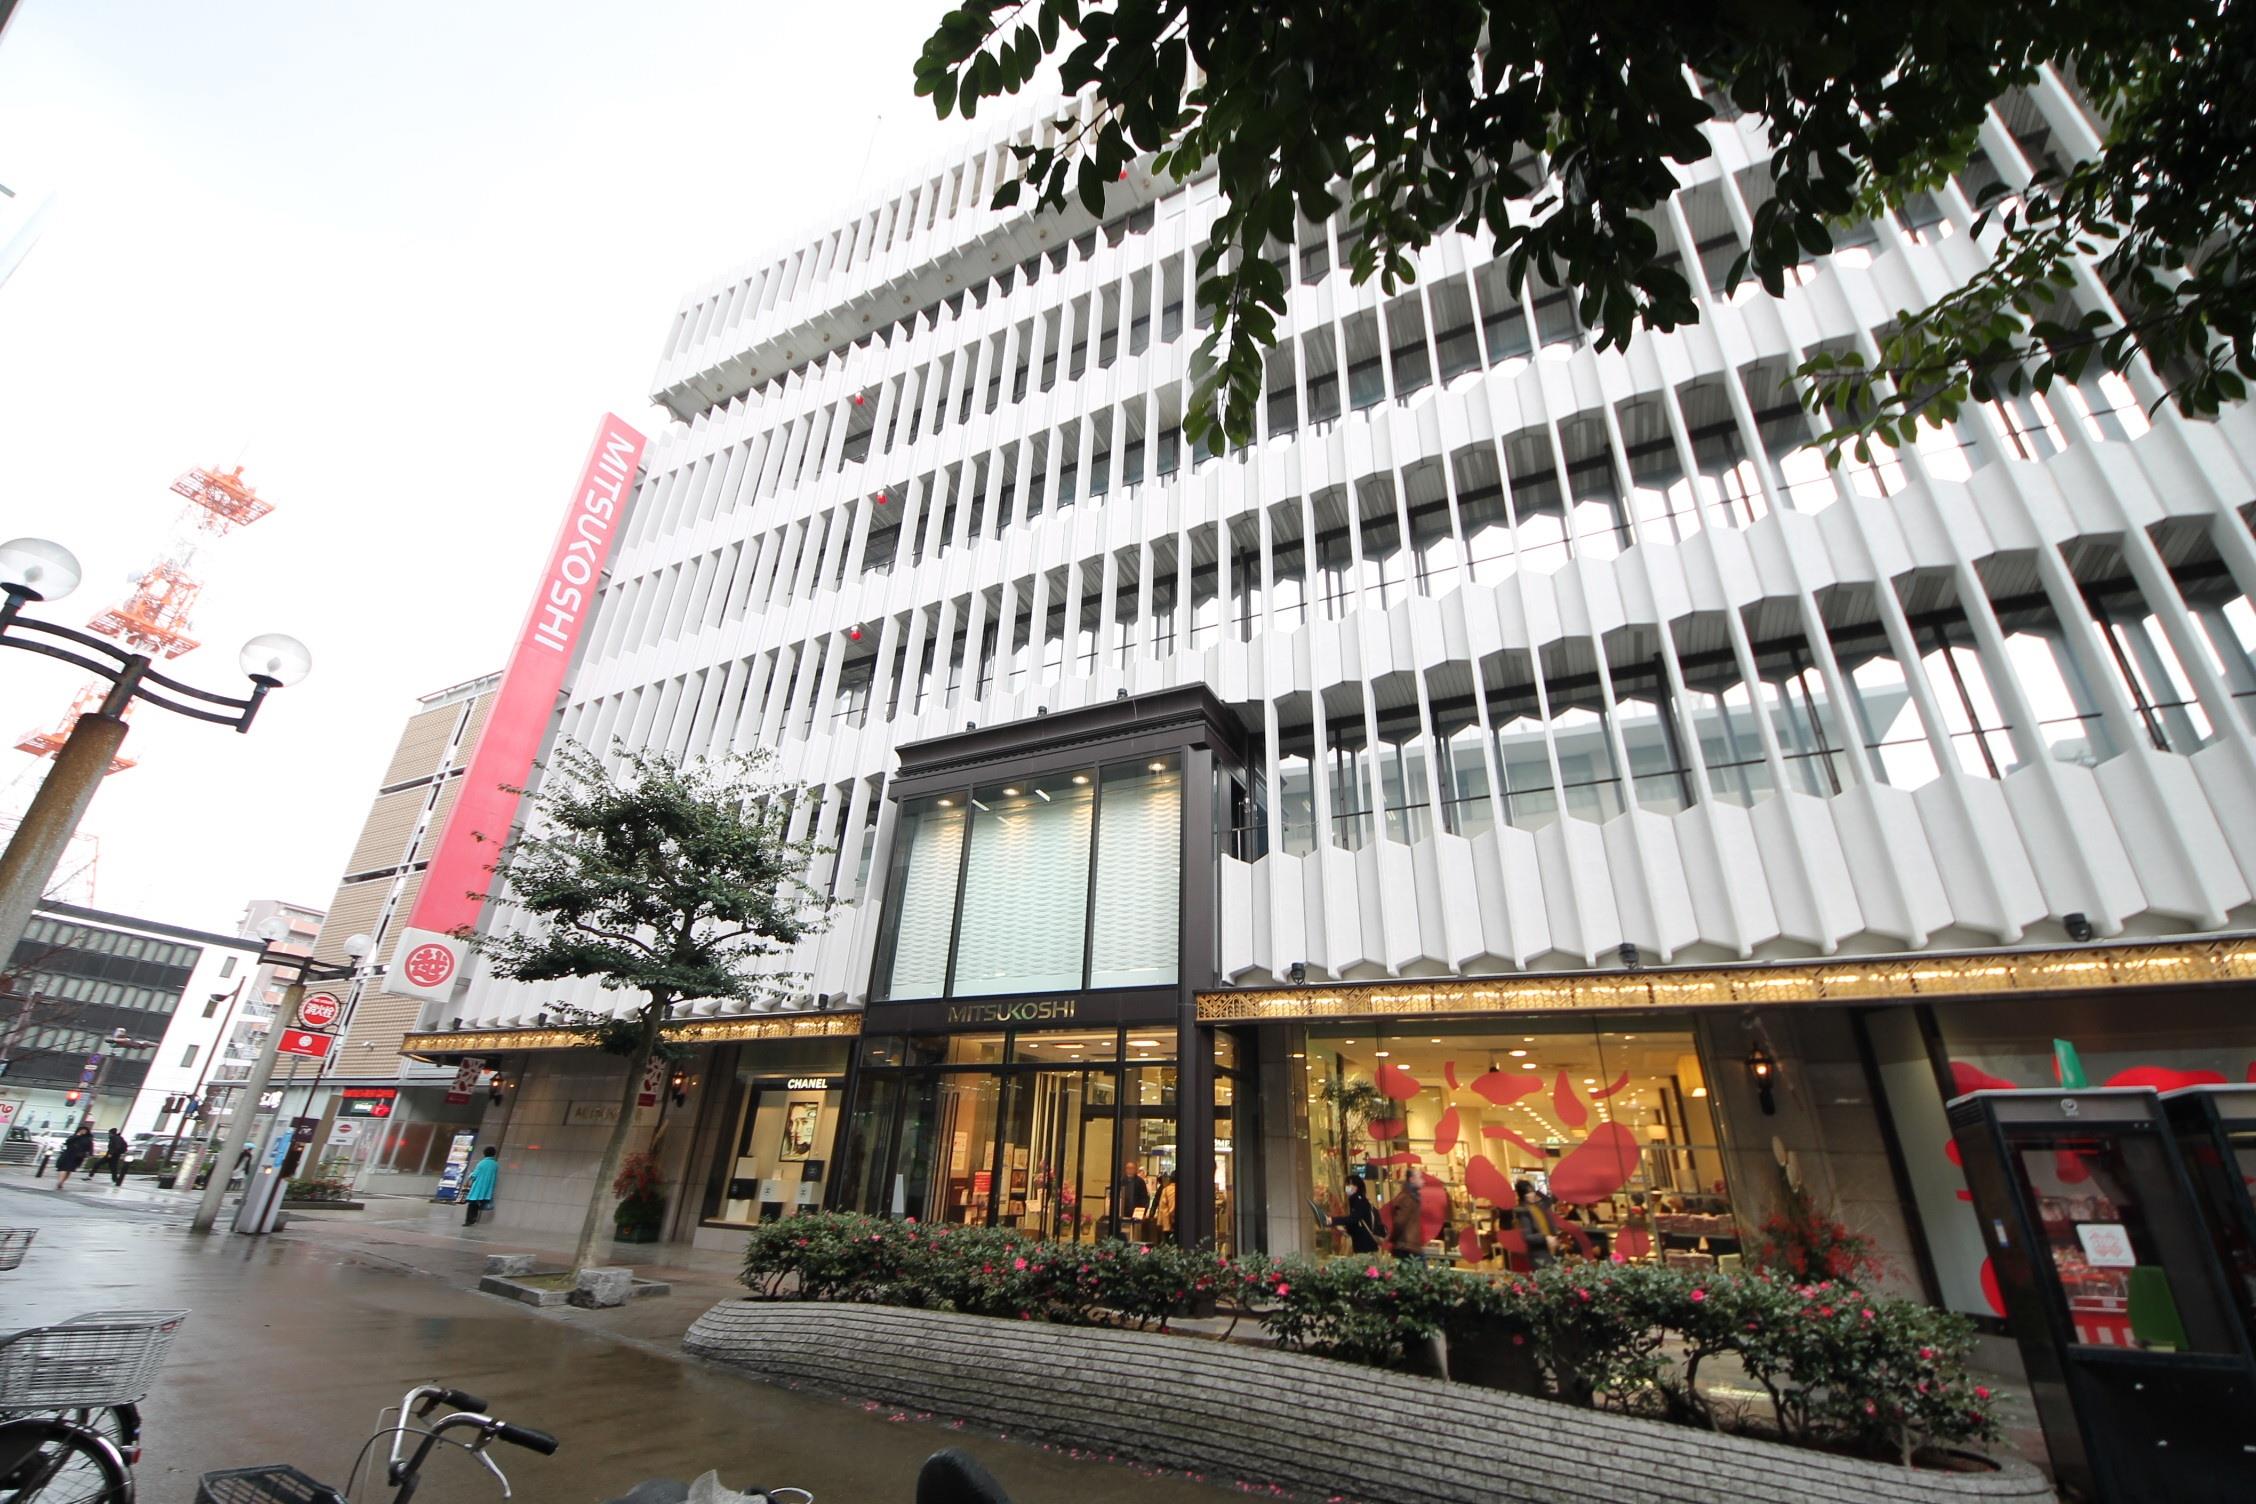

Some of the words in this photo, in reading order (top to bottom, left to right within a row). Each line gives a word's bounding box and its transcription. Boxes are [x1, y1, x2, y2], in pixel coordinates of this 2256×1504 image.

[534, 431, 636, 652] MITSUKOSHI
[305, 1003, 334, 1018] 消火栓
[948, 1000, 1075, 1023] MITSUKOSHI
[787, 1078, 828, 1089] CHANEL
